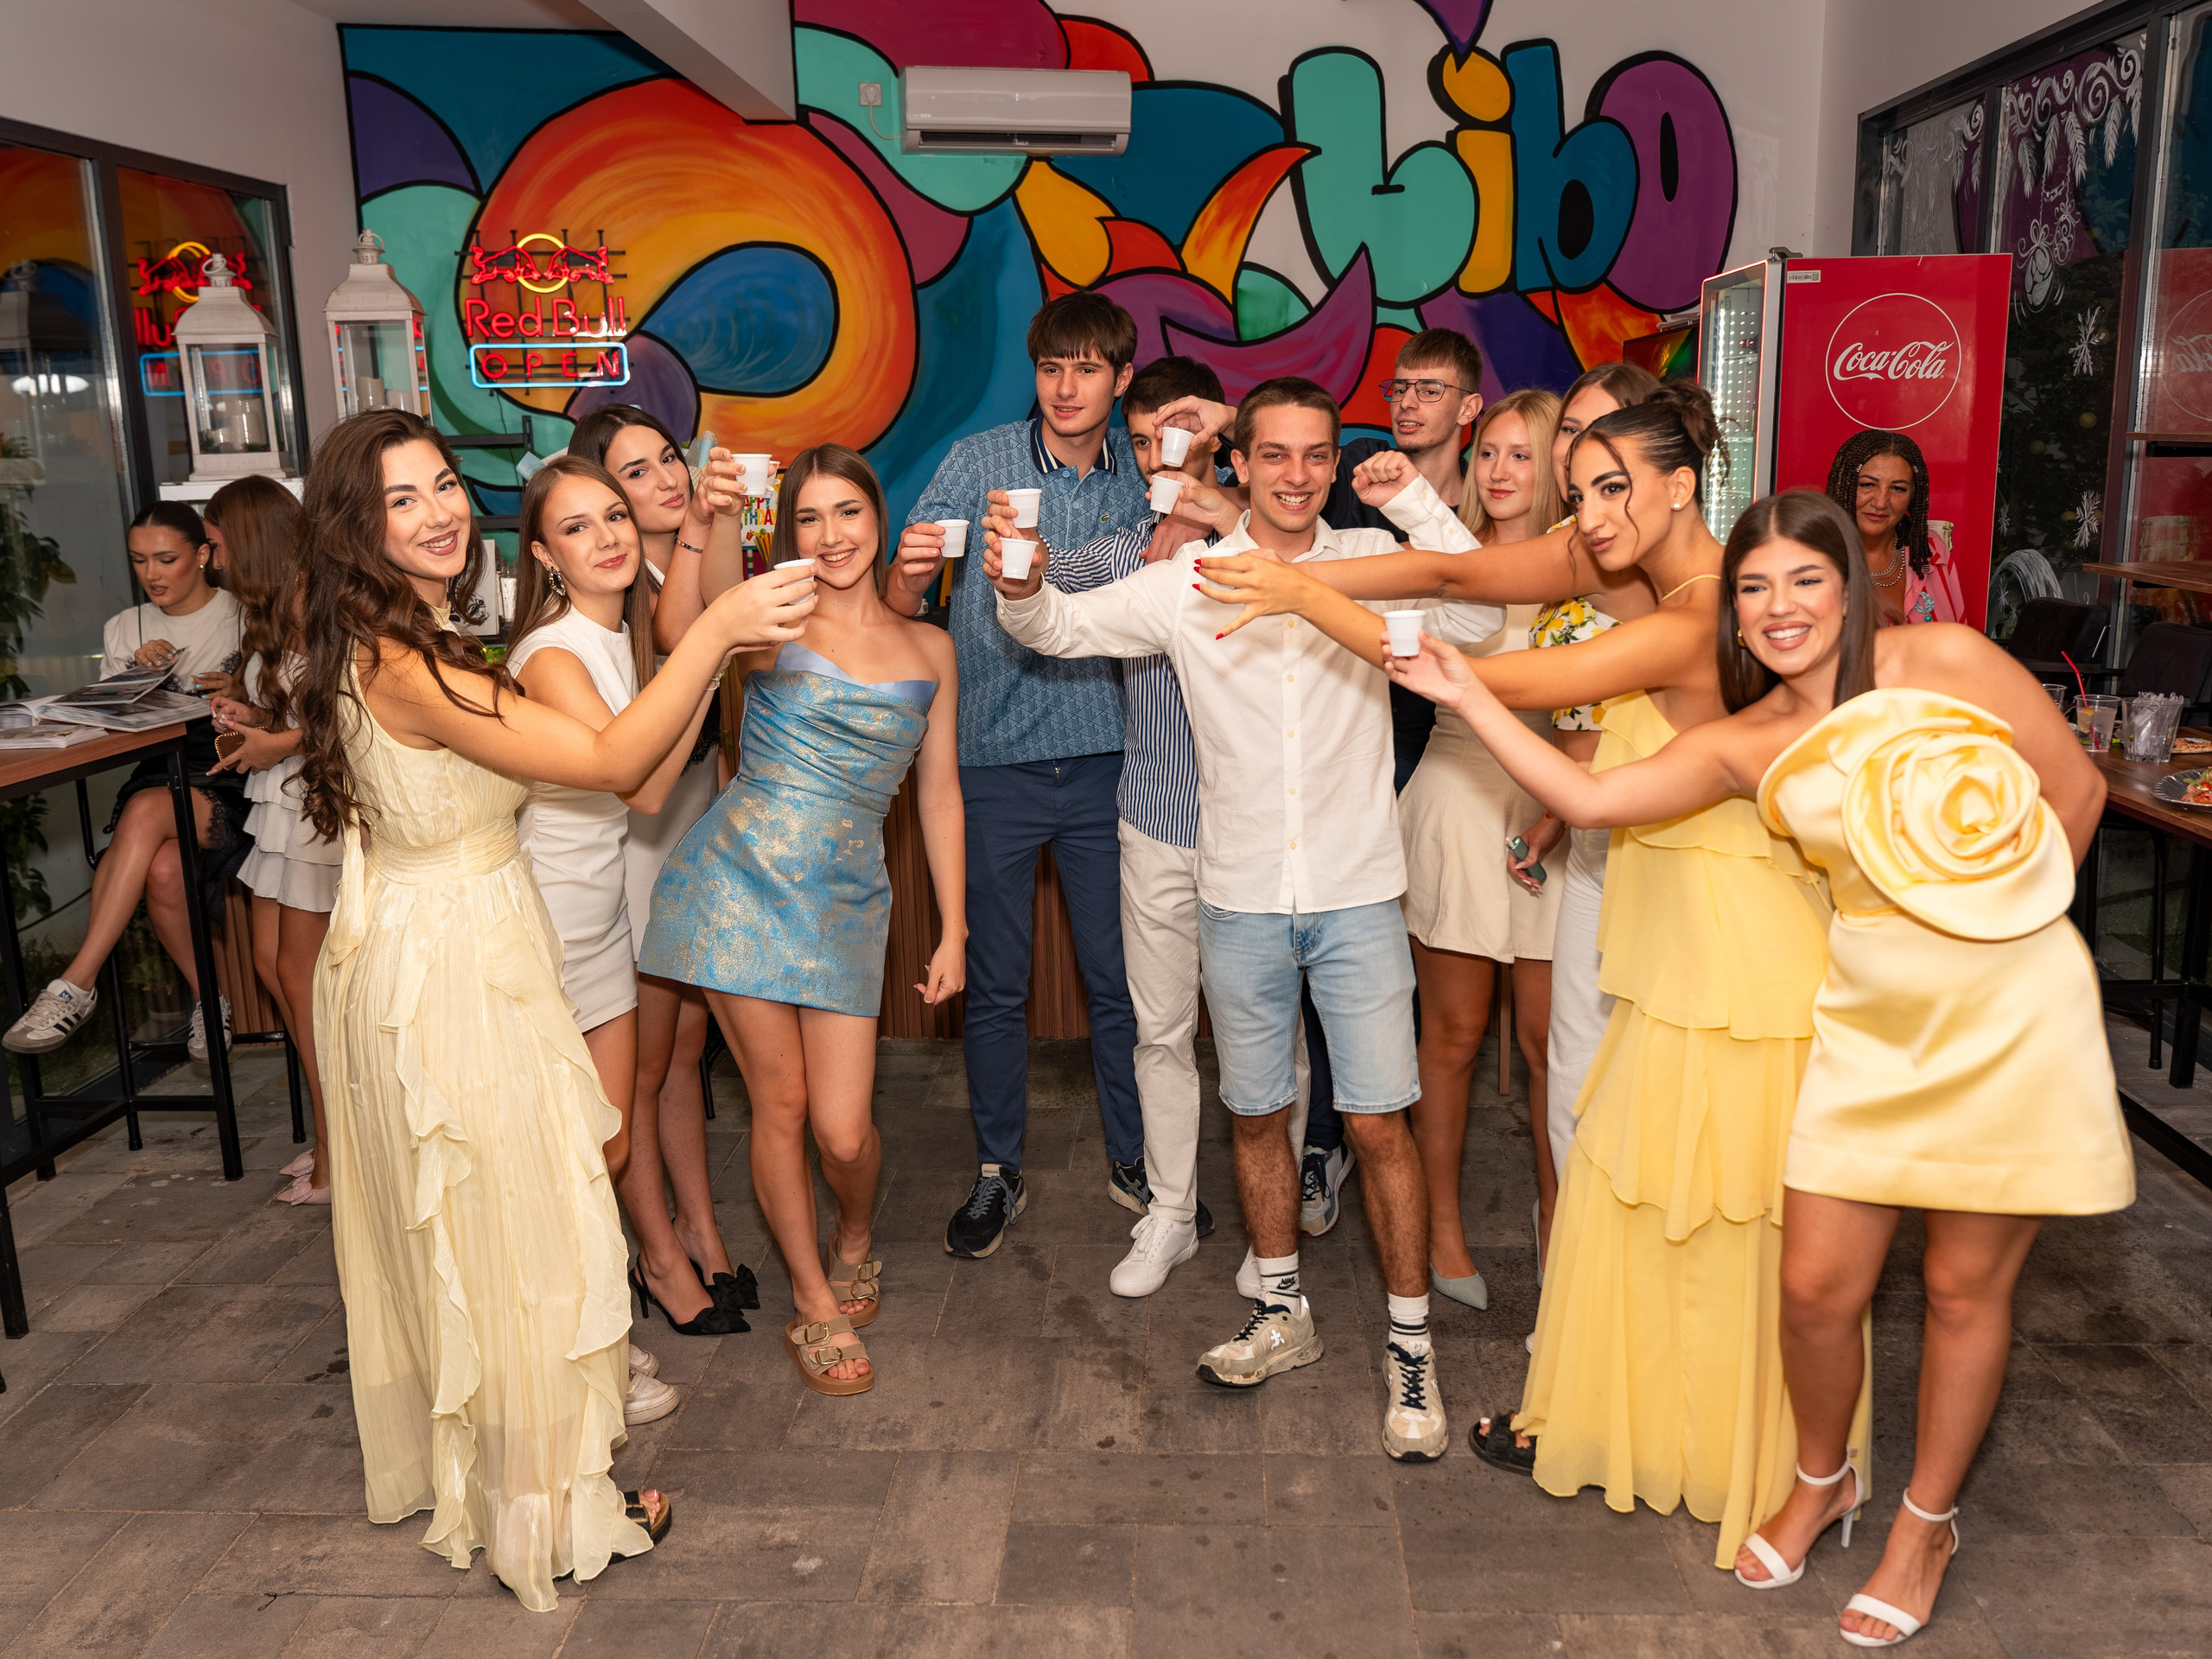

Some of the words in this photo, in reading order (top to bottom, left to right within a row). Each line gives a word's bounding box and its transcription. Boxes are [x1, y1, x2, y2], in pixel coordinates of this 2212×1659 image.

[465, 296, 543, 338] Red
[552, 296, 627, 338] Bull
[481, 352, 619, 378] OPEN
[1833, 340, 1955, 381] Coca-Cola
